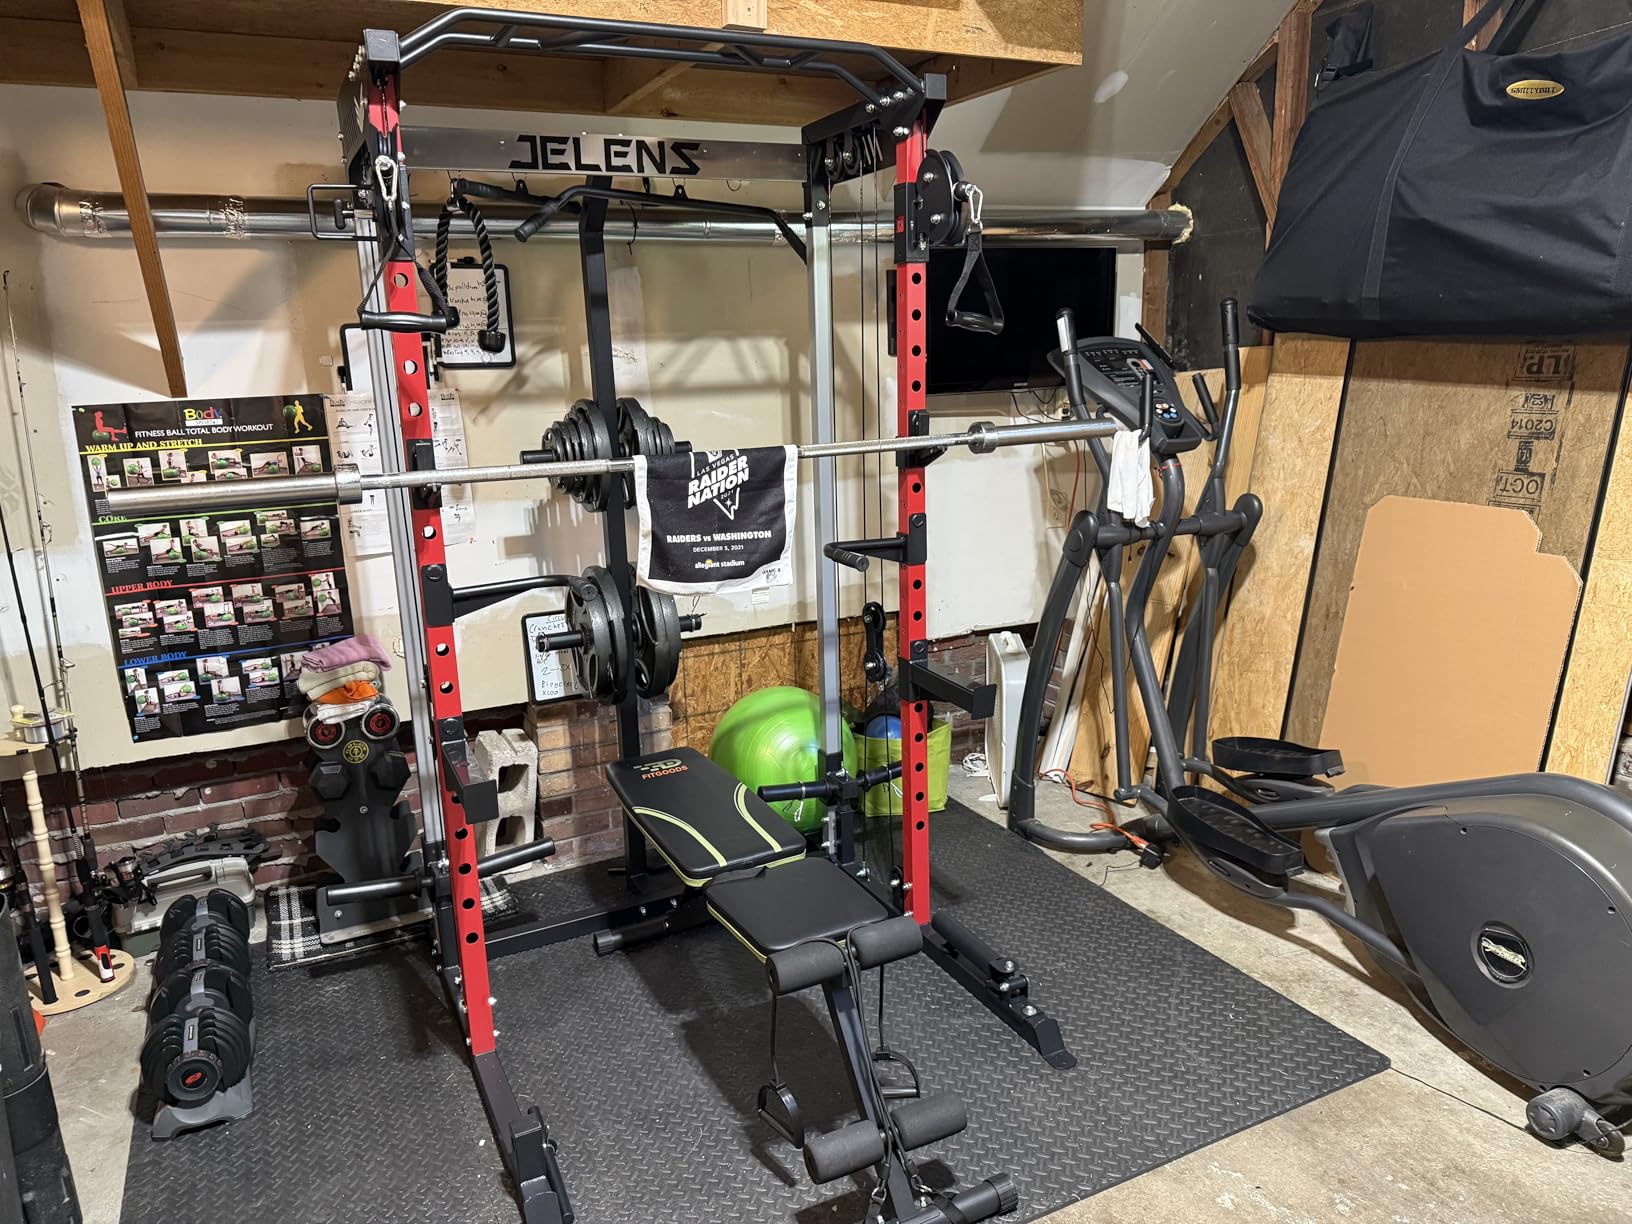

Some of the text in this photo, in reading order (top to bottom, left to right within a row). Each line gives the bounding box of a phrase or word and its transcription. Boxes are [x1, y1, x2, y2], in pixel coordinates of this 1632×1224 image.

[135, 423, 273, 438] FITNESS BALL TOTAL BODY WORKOUT
[1510, 418, 1553, 432] C2014
[85, 438, 202, 453] WARM UP AND STRETCH
[697, 453, 734, 477] LAS VEGAS
[688, 455, 749, 496] RAIDER
[687, 467, 749, 509] NATION
[1500, 477, 1539, 495] OCT
[720, 490, 734, 500] 2021
[666, 534, 702, 543] RAIDERS
[712, 531, 772, 541] WASHINGTON
[695, 559, 720, 569] allegiant
[111, 580, 173, 594] UPPER BODY
[124, 651, 187, 667] LOWER BODY
[641, 765, 689, 780] FITGOODS
